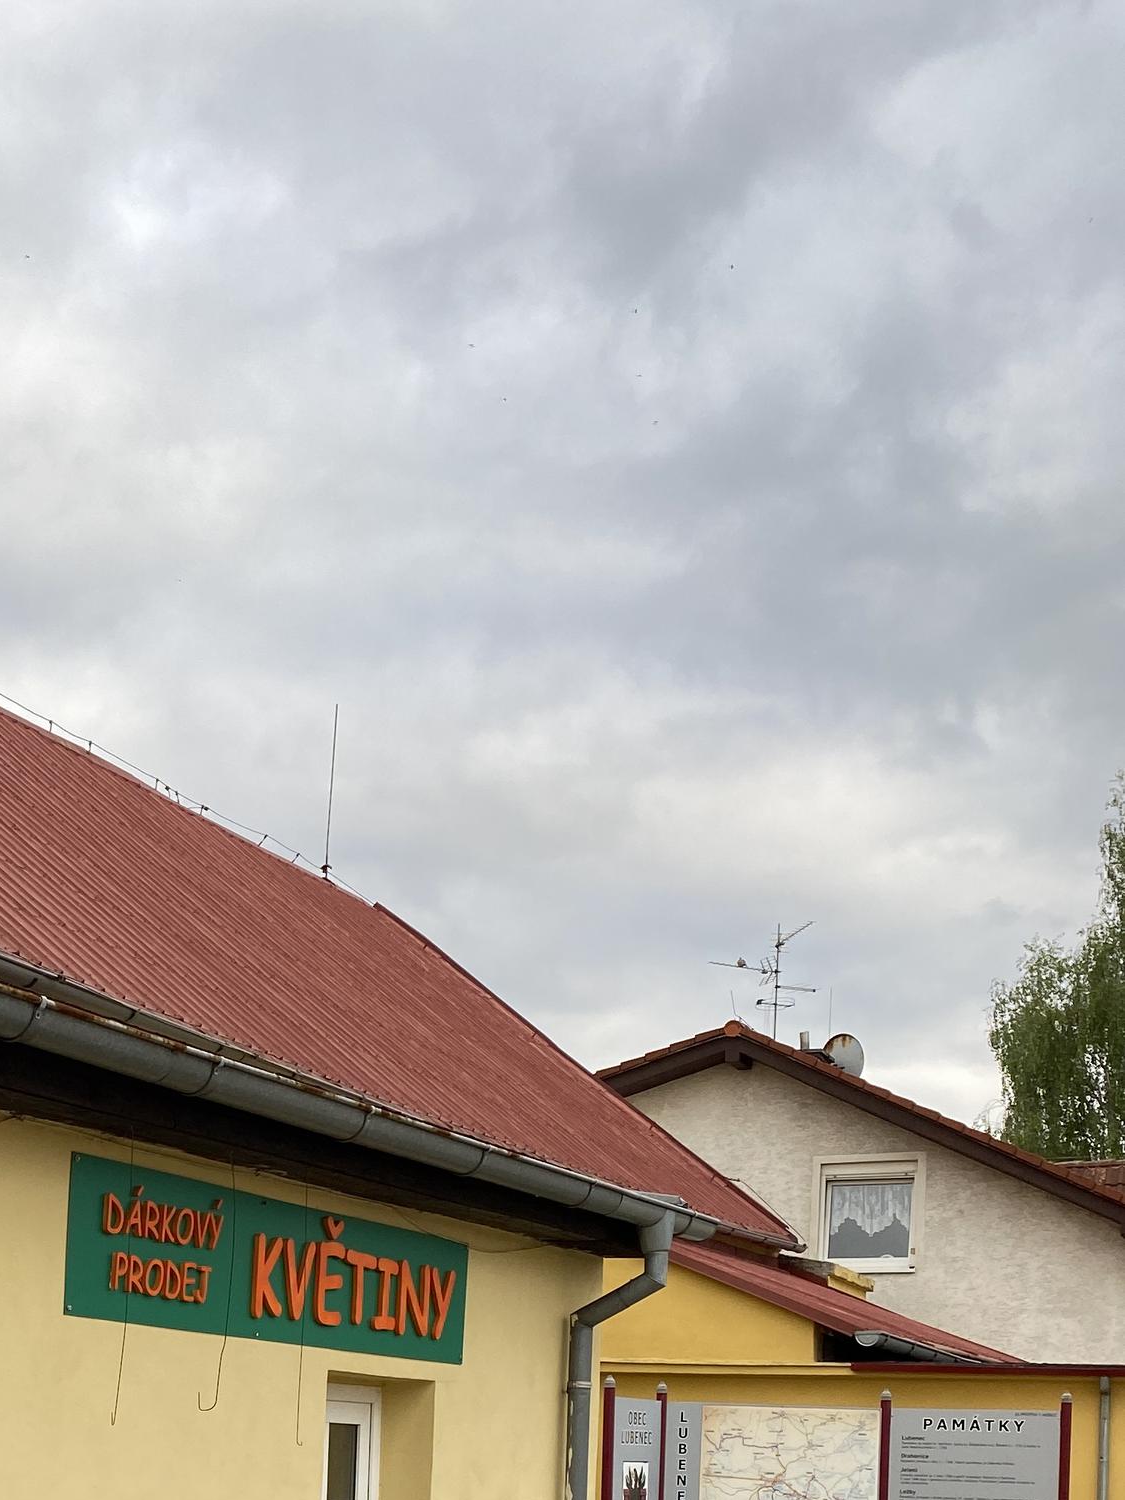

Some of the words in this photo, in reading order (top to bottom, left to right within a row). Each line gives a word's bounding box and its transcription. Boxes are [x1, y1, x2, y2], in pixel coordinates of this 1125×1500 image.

[102, 1185, 225, 1250] DÁRKOVÝ
[109, 1251, 213, 1304] PRODEJ
[251, 1215, 457, 1341] KVĚTINY
[628, 1411, 647, 1426] OBEC
[923, 1415, 1025, 1432] PAMÁTKY
[621, 1431, 653, 1445] LUBENEC
